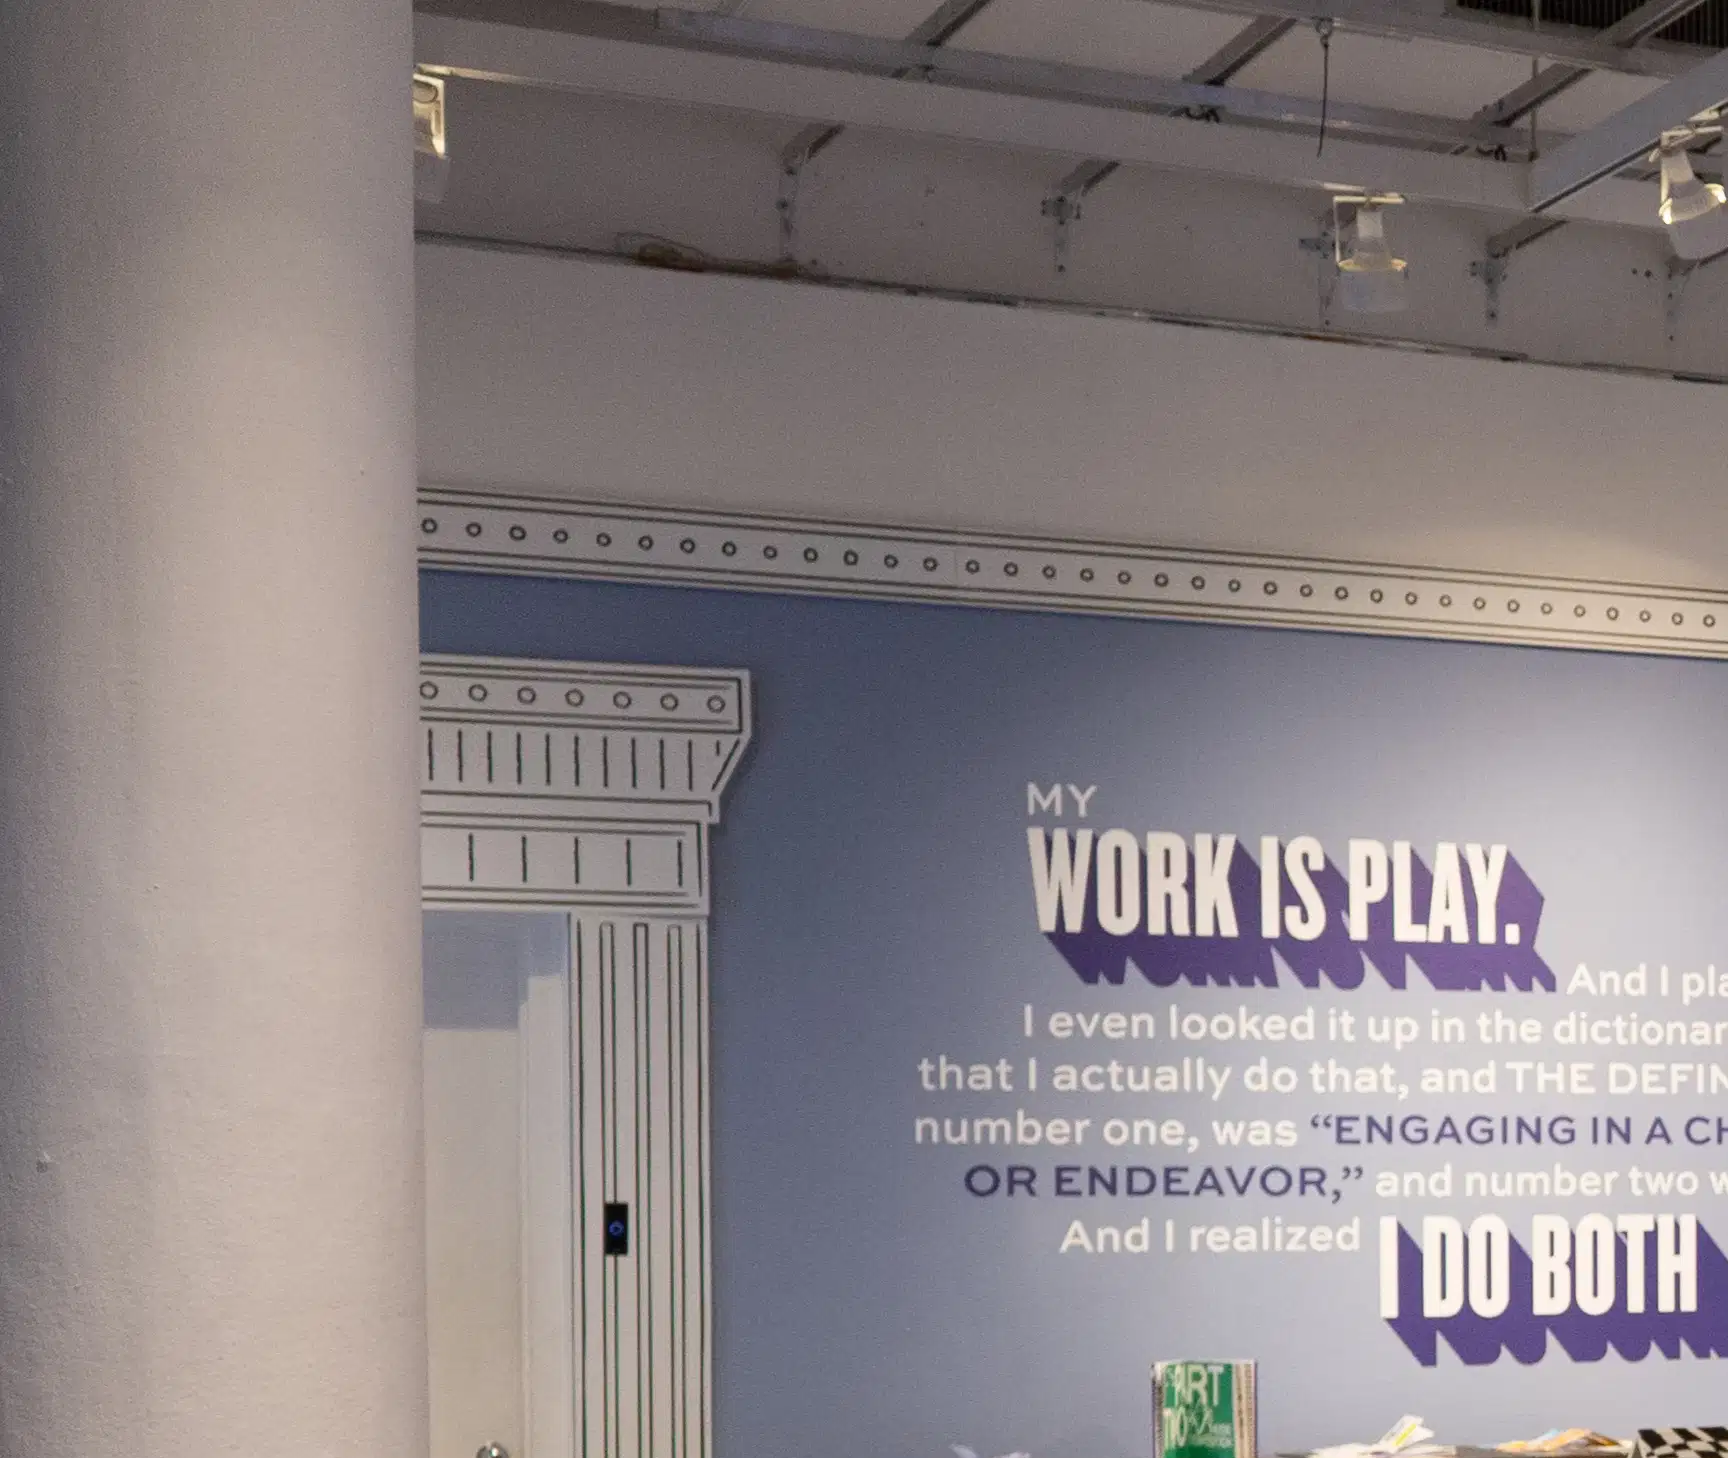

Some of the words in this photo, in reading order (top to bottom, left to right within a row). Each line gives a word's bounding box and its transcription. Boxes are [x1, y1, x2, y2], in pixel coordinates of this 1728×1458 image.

[1027, 784, 1097, 817] MY
[1027, 827, 1238, 937] WORK
[1261, 835, 1326, 941] IS
[1350, 837, 1520, 944] PLAY.
[1566, 963, 1647, 997] And
[1660, 966, 1669, 997] I
[1024, 1004, 1032, 1037] I
[1049, 1009, 1155, 1039] even
[1169, 1004, 1314, 1041] looked
[1328, 1008, 1355, 1042] it
[1368, 1017, 1418, 1050] up
[1432, 1010, 1466, 1043] in
[1477, 1009, 1543, 1045] the
[917, 1056, 1012, 1091] that
[1028, 1058, 1036, 1091] I
[1052, 1058, 1232, 1100] actually
[1244, 1059, 1298, 1093] do
[1309, 1059, 1410, 1099] that,
[1421, 1060, 1496, 1094] and
[1506, 1062, 1595, 1094] THE
[915, 1109, 1089, 1145] number
[1103, 1117, 1200, 1152] one,
[1212, 1119, 1297, 1146] was
[1310, 1114, 1576, 1145] “ENGAGING
[1593, 1116, 1631, 1144] IN
[1645, 1116, 1673, 1144] A
[964, 1165, 1037, 1198] OR
[1054, 1165, 1363, 1204] ENDEAVOR,”
[1375, 1163, 1451, 1197] and
[1466, 1163, 1617, 1196] number
[1628, 1170, 1700, 1195] two
[1059, 1217, 1149, 1253] And
[1165, 1219, 1174, 1252] I
[1189, 1216, 1361, 1253] realized
[1379, 1215, 1397, 1318] I
[1422, 1214, 1510, 1318] DO
[1532, 1213, 1699, 1317] BOTH
